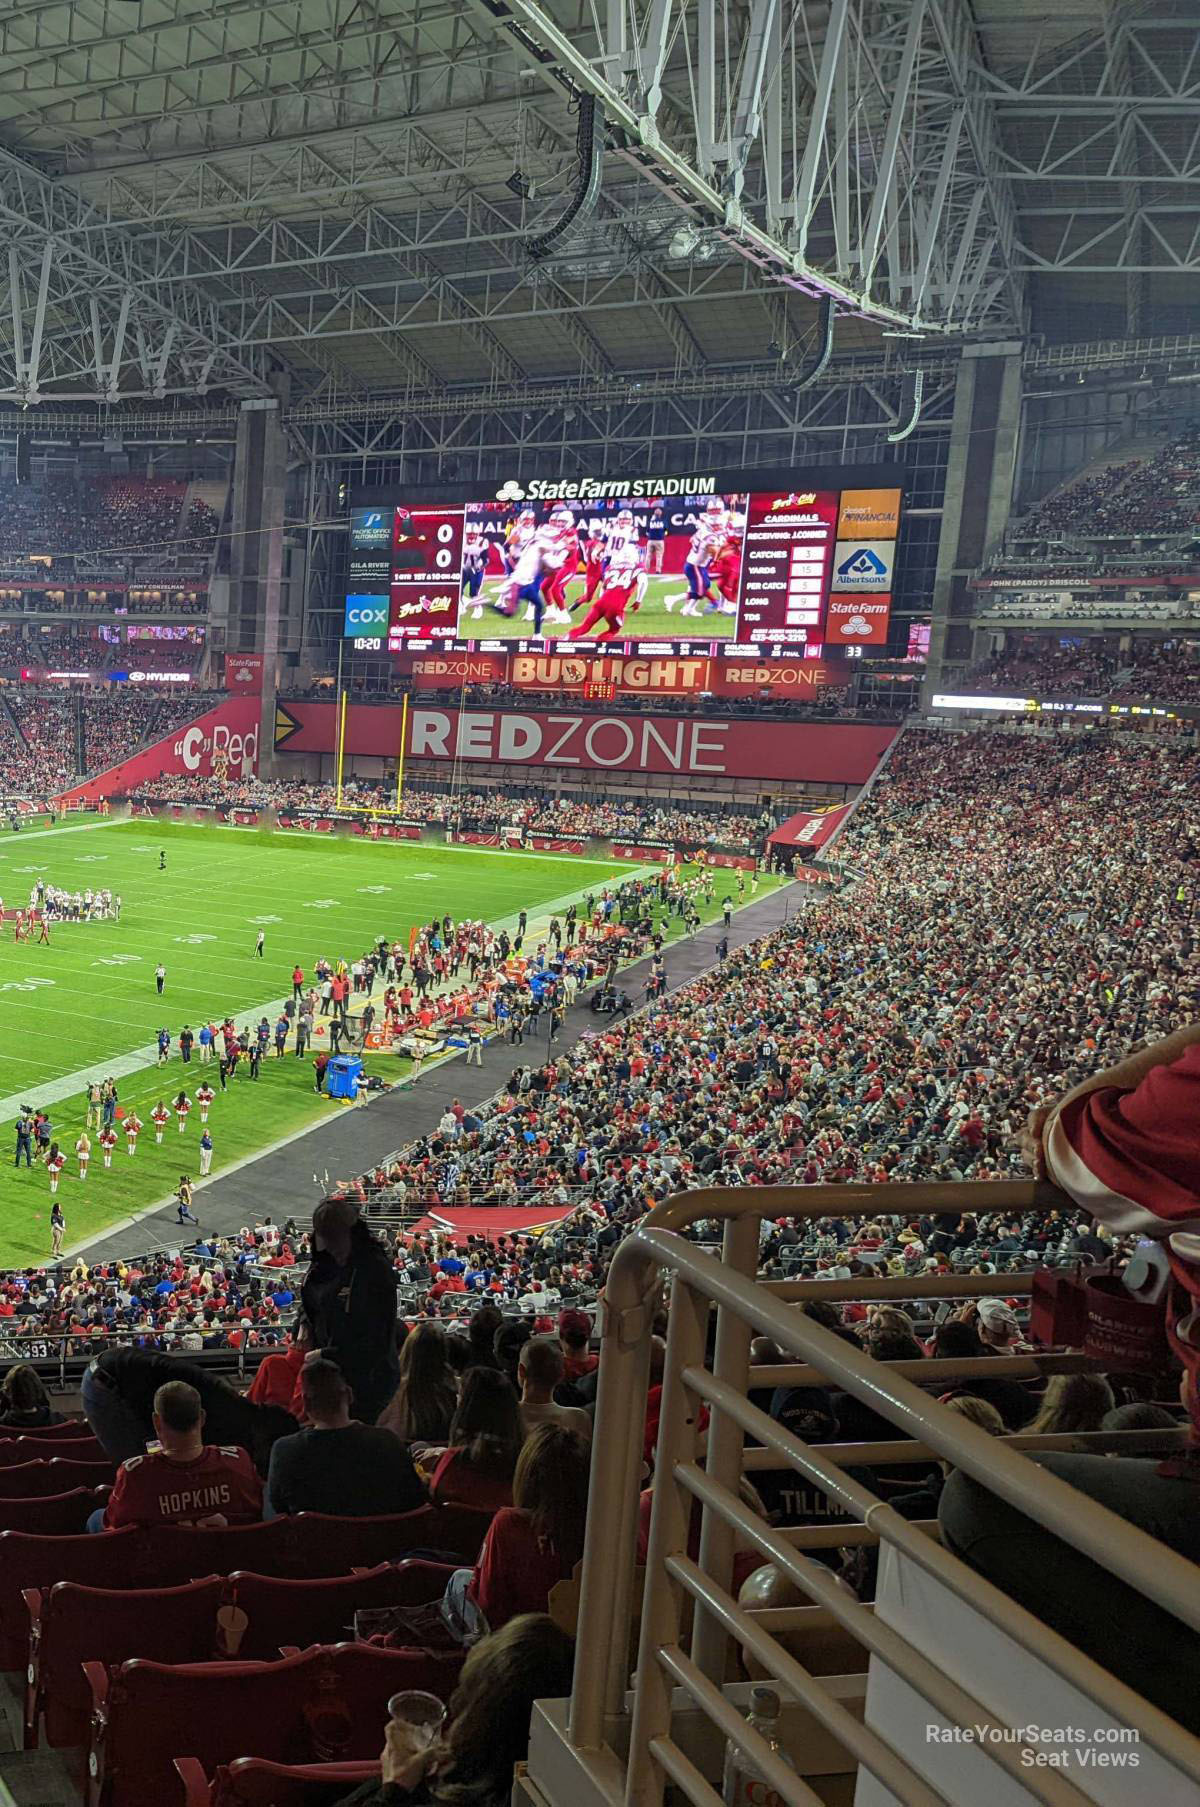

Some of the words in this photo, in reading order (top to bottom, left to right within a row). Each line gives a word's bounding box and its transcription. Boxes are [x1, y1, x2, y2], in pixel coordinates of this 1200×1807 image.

[632, 478, 715, 496] STADIUM
[764, 513, 819, 523] CARDINALS
[846, 512, 896, 521] FINANCIAL
[437, 524, 453, 543] 0
[436, 549, 452, 568] 0
[749, 551, 787, 559] CATCHES
[749, 566, 776, 574] YARDS
[606, 569, 632, 590] 34
[762, 582, 787, 590] CATCH
[836, 575, 886, 584] Albertsons
[745, 597, 769, 606] LONG
[348, 609, 386, 623] COX
[354, 638, 380, 650] 10:20
[847, 646, 862, 657] 33
[412, 661, 492, 677] REDZONE
[513, 657, 587, 684] BUD
[592, 659, 702, 687] LIGHT
[725, 668, 826, 685] REDZONE
[410, 710, 729, 772] REDZONE
[100, 953, 143, 966] 40
[2, 976, 56, 991] 30
[372, 1034, 381, 1043] G
[762, 1045, 770, 1056] 10
[31, 1344, 47, 1358] 93
[158, 1484, 231, 1515] HOPKINS
